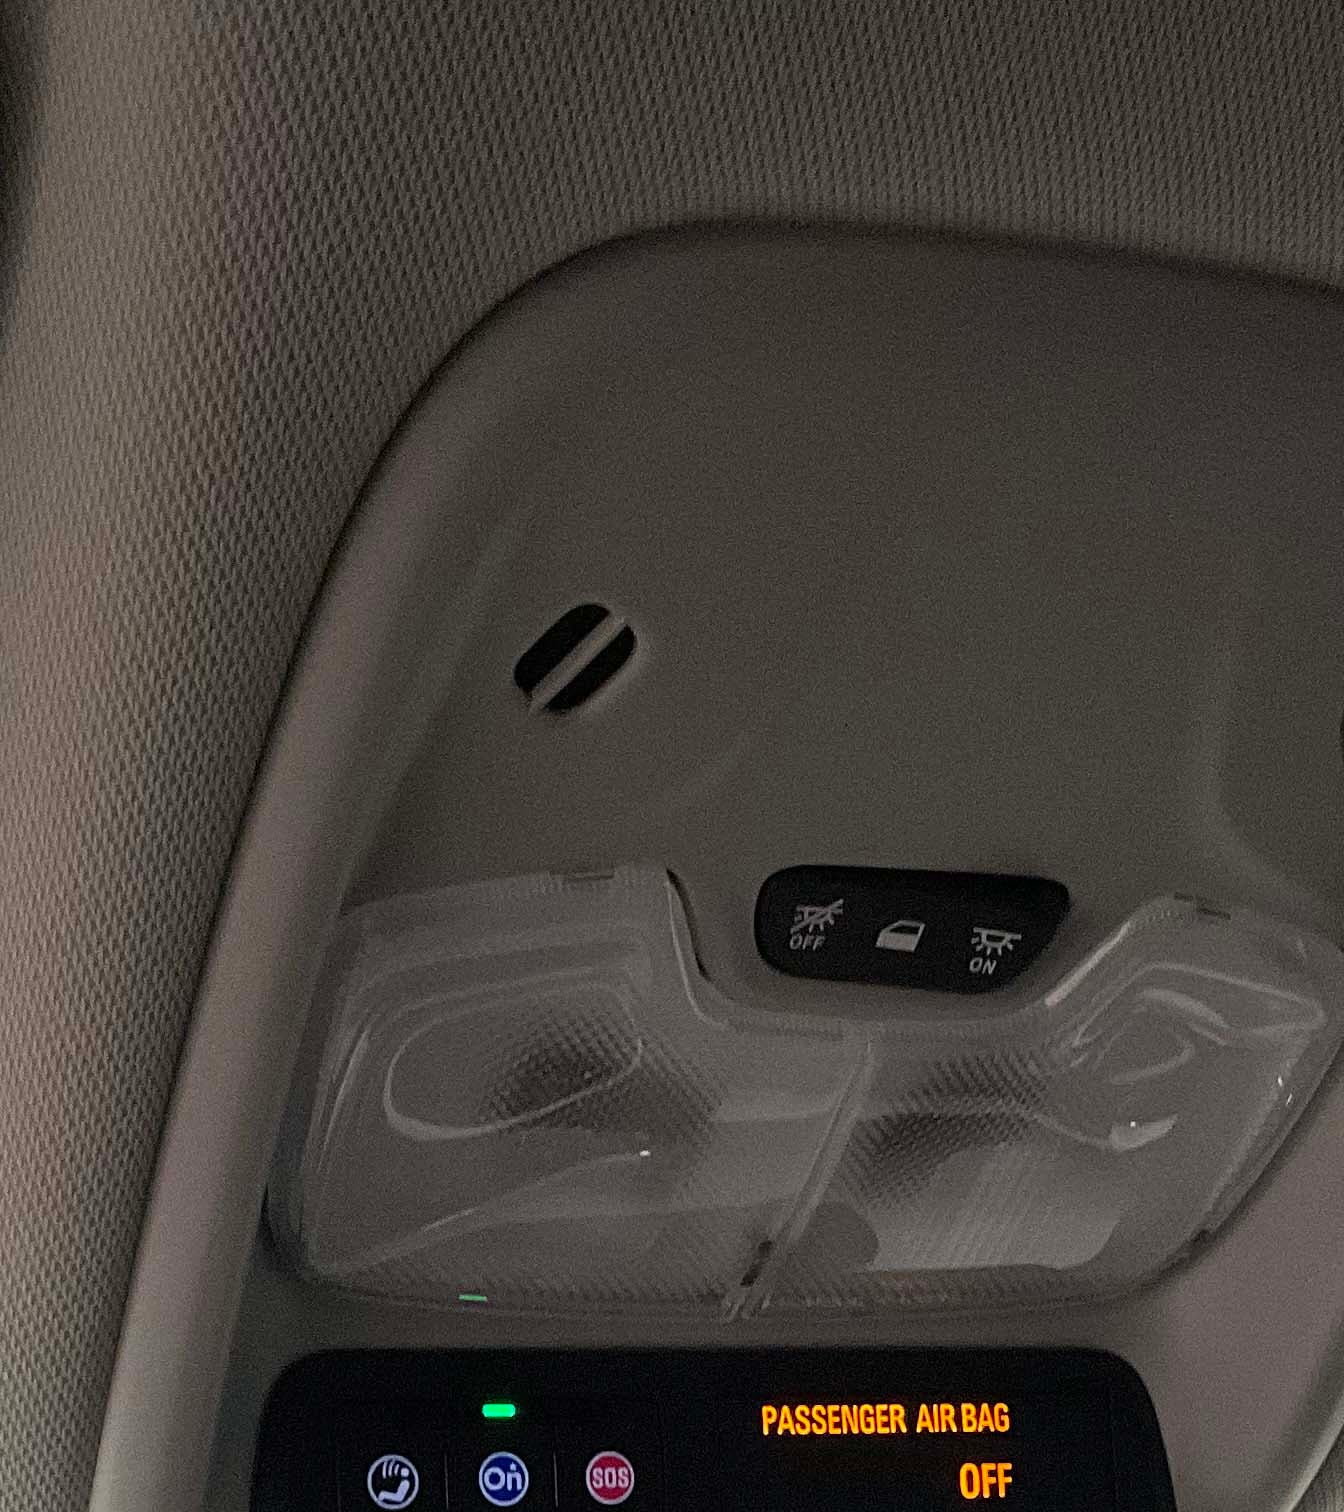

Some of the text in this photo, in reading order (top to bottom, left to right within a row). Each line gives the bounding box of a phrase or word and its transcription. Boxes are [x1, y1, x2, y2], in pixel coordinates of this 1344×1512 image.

[789, 935, 826, 950] OFF
[969, 958, 997, 975] ON
[761, 1402, 1010, 1436] PASSENGER AIR BAG
[591, 1464, 631, 1490] SOS
[959, 1462, 1013, 1500] OFF
